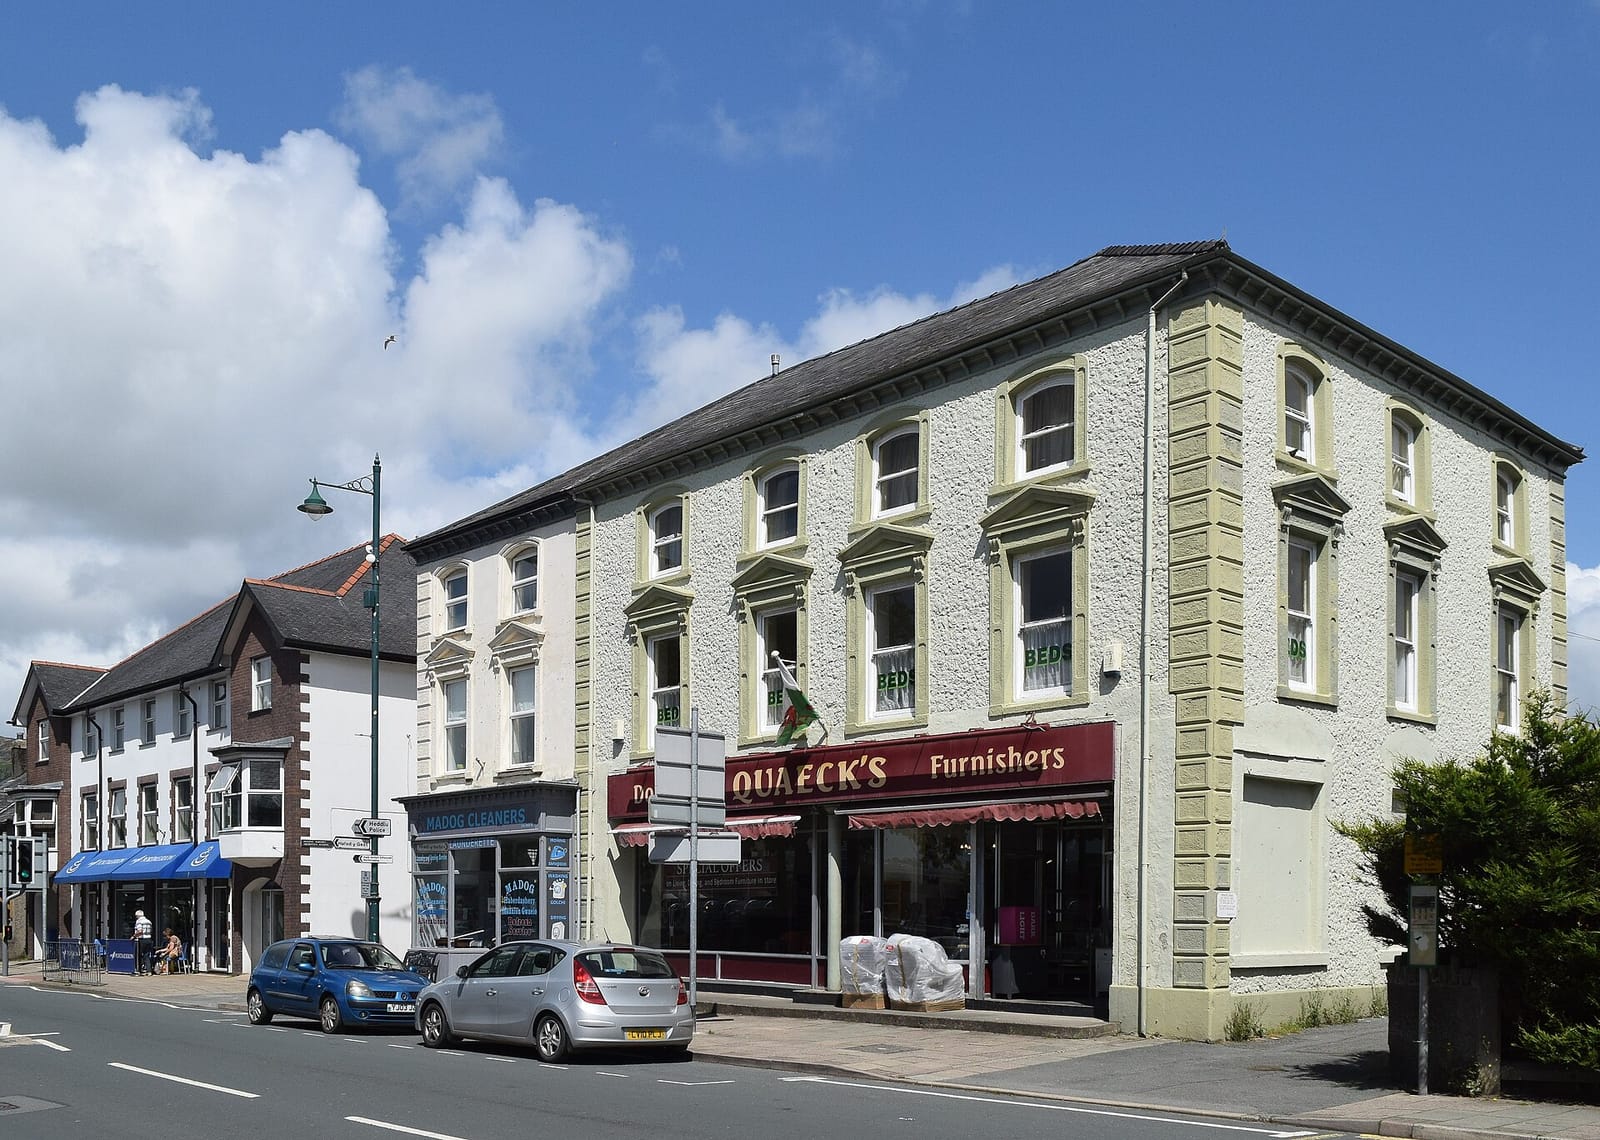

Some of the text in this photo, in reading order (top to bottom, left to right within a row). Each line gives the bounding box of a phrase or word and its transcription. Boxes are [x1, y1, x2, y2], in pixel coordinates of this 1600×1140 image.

[1025, 643, 1072, 667] BEDS
[732, 756, 887, 804] QUAECK'S
[930, 745, 1065, 779] Furnishers
[426, 814, 464, 831] MADOG
[468, 808, 526, 827] CLEANERS
[505, 879, 535, 895] MADOG
